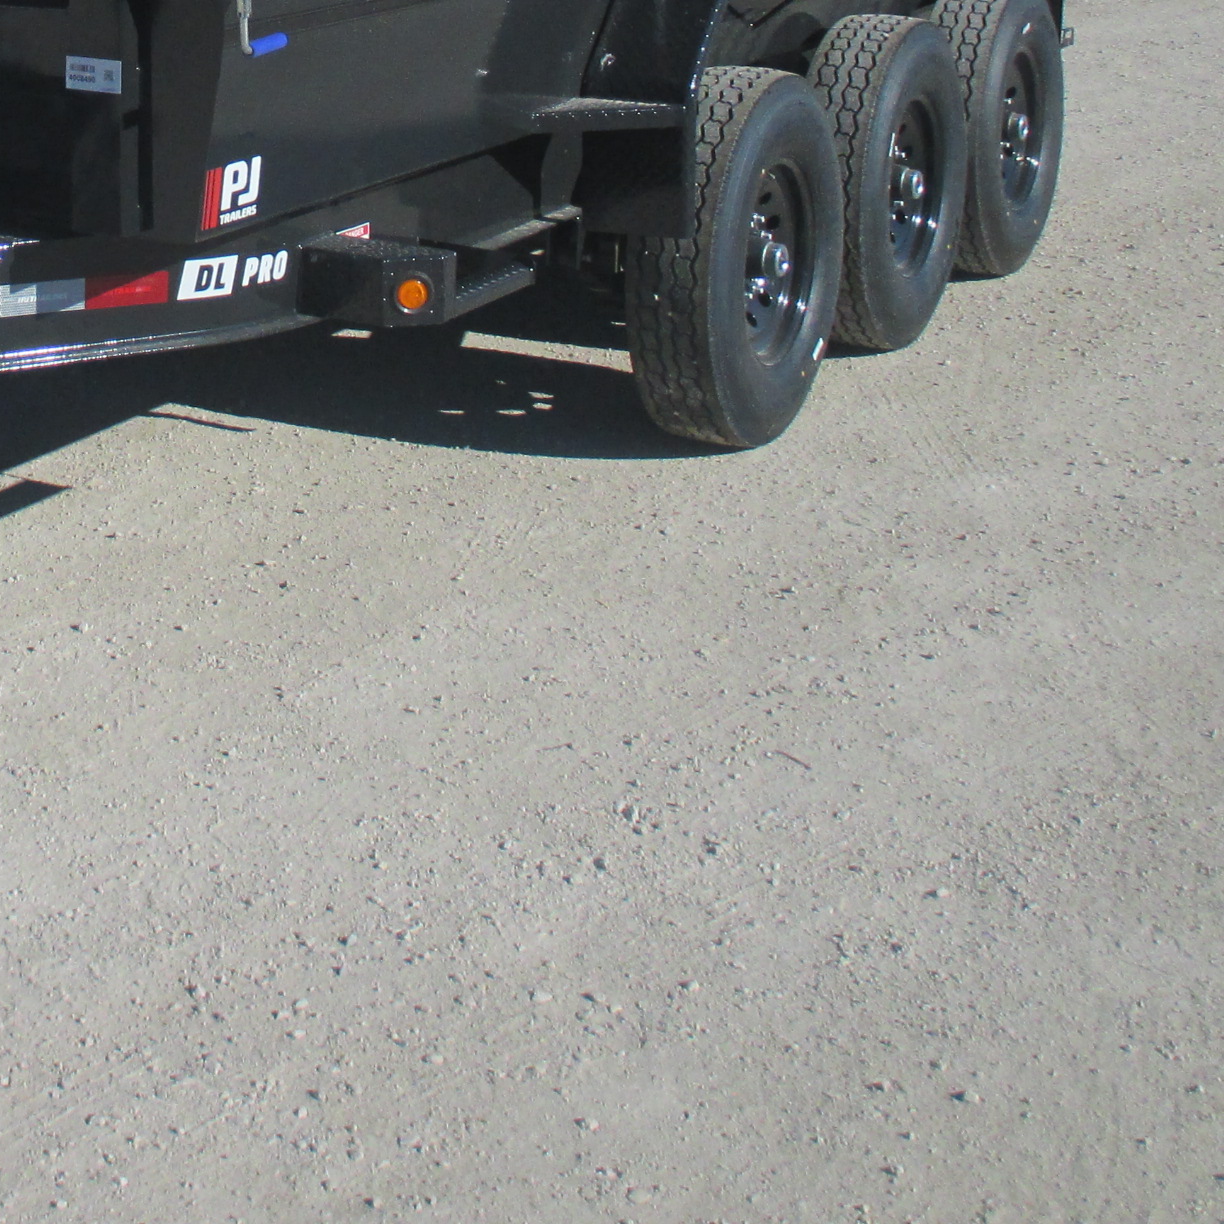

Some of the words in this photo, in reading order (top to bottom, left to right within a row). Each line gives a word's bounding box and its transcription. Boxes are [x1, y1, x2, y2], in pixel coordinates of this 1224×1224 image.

[220, 156, 262, 211] PJ
[219, 204, 257, 225] TRAILERS
[194, 263, 227, 293] DL
[241, 250, 289, 288] PRO
